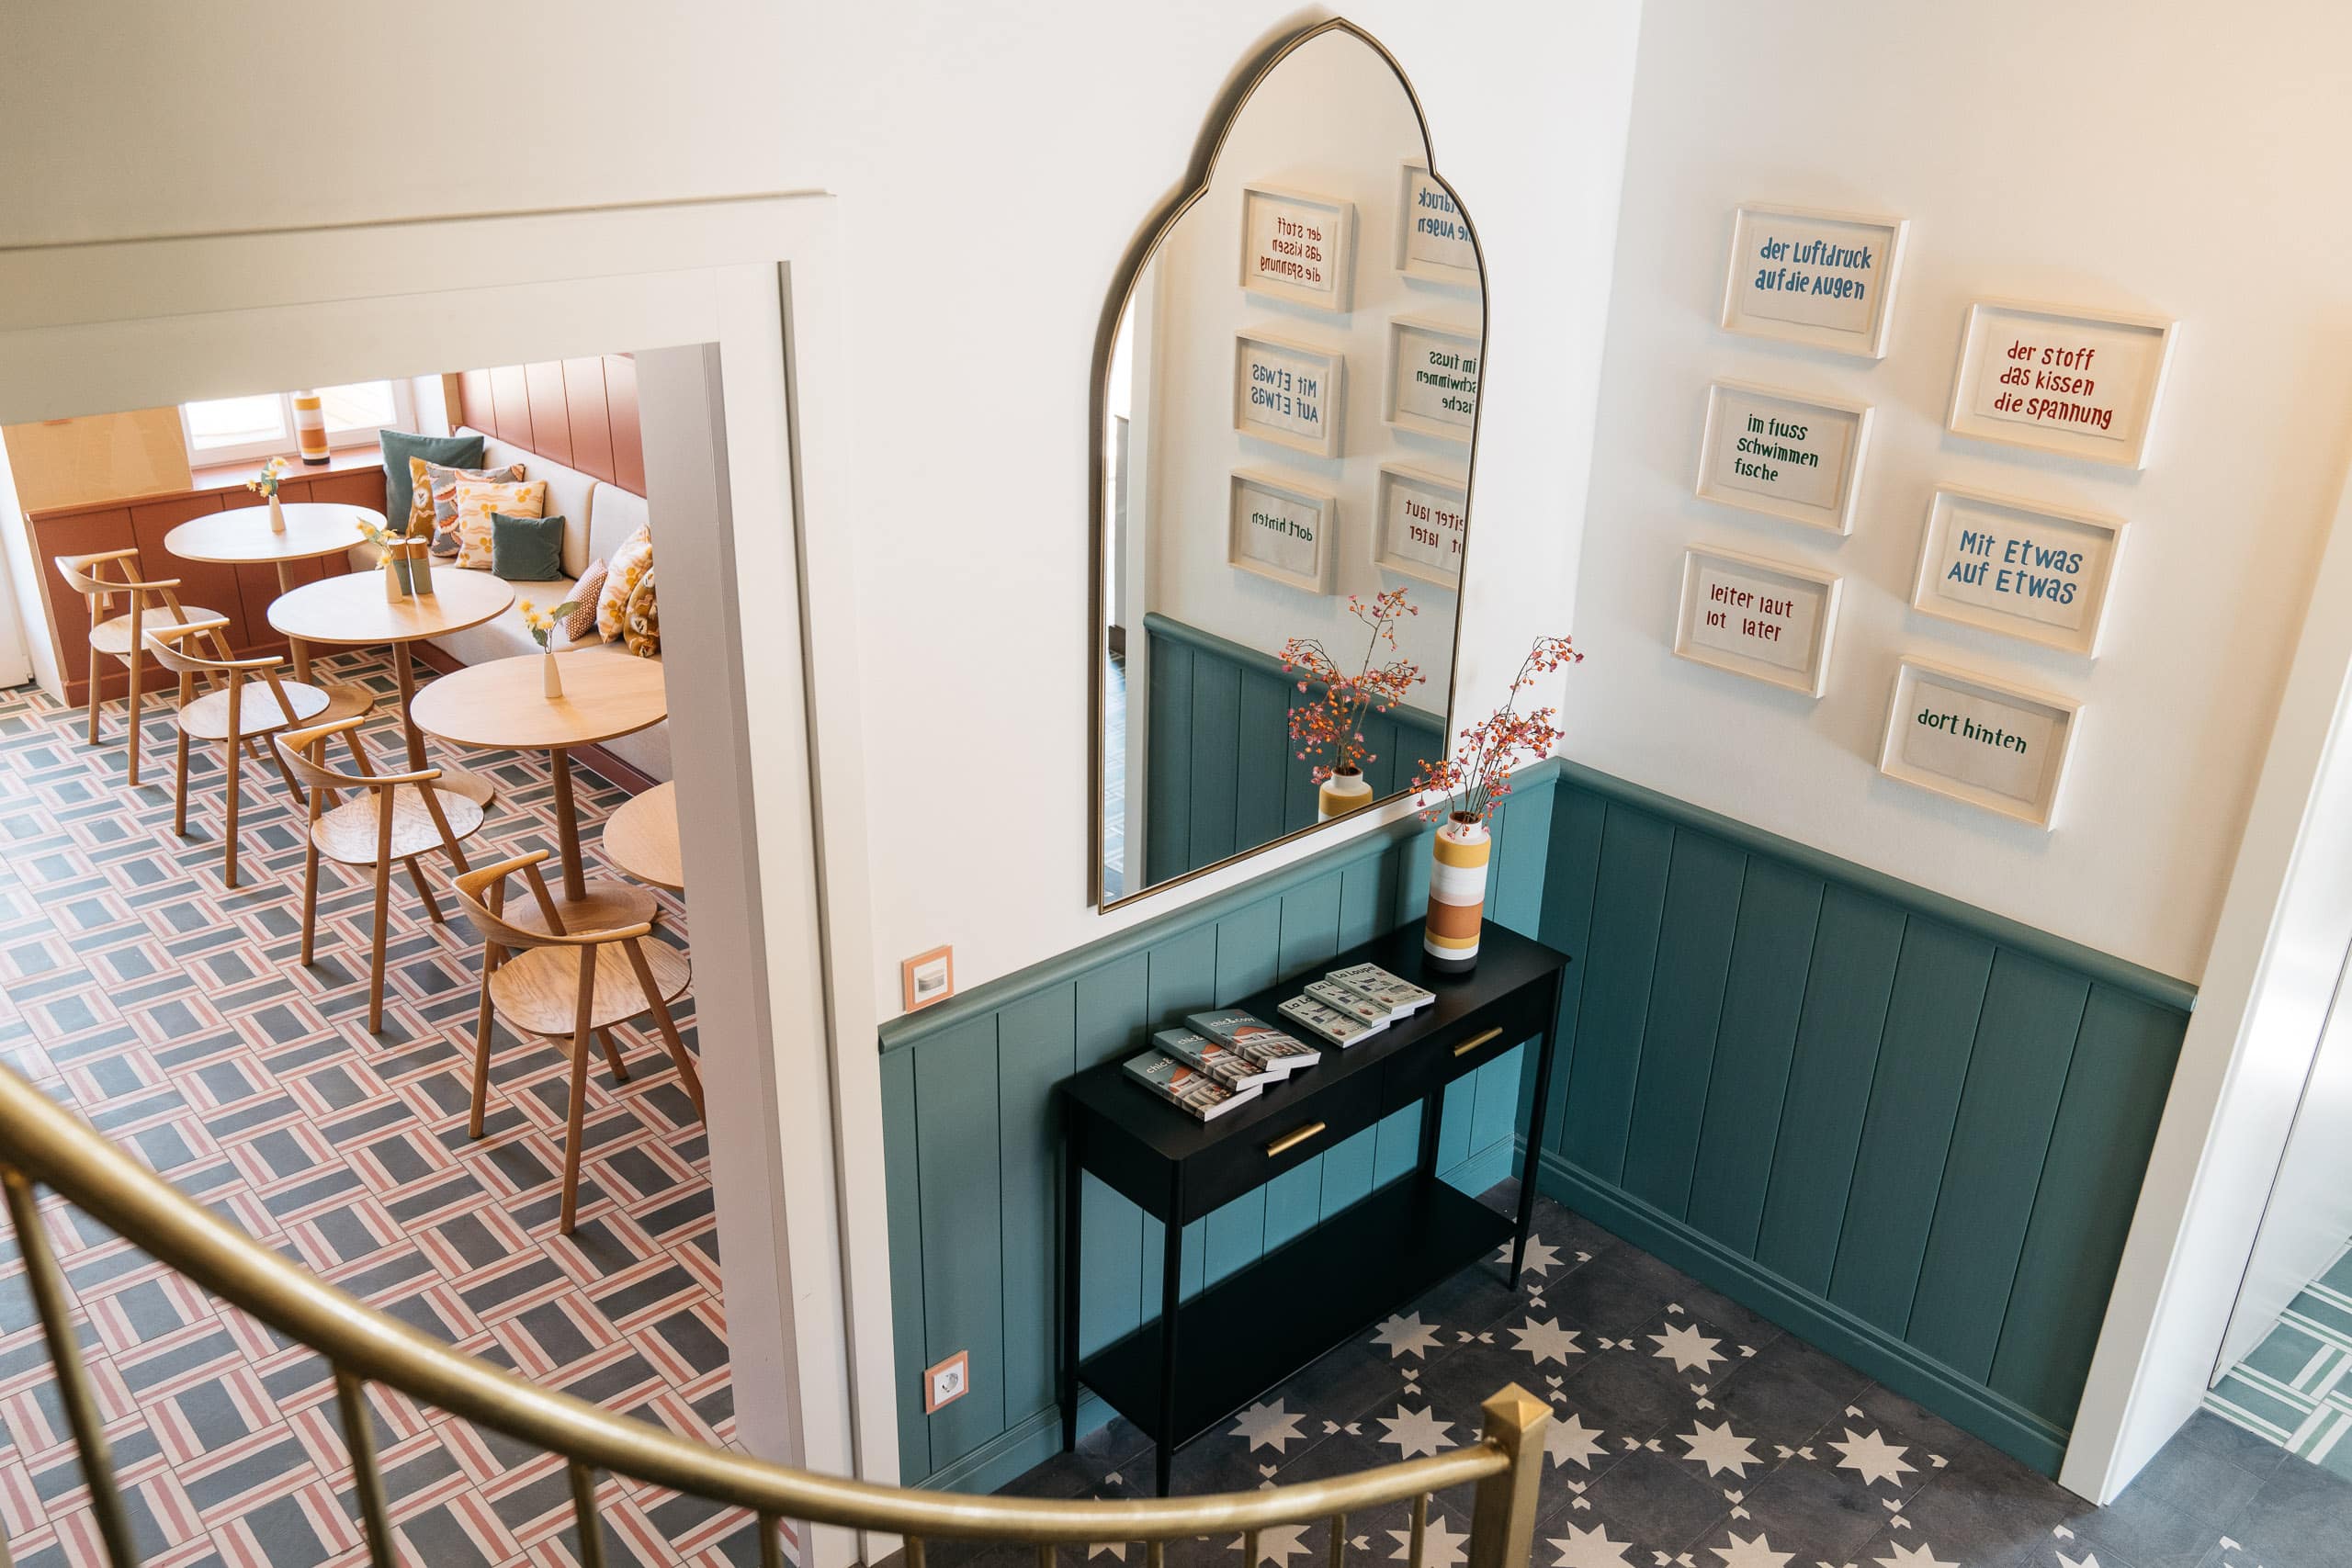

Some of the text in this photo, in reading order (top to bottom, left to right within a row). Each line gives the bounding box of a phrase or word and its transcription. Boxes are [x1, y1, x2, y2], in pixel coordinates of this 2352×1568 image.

[1759, 236, 1872, 269] der Luftdruck
[1755, 268, 1865, 300] auf die Augen
[2007, 340, 2037, 361] der
[1999, 367, 2095, 396] das kissen
[1994, 391, 2023, 412] die
[1747, 413, 1809, 441] im fluss
[1735, 457, 1779, 481] fische
[1960, 530, 2084, 574] Mit Etwas
[1947, 561, 2077, 604] Auf Etwas
[1710, 583, 1794, 618] leiter laut
[1706, 610, 1782, 642] lot later
[1917, 708, 2028, 754] dort hinten
